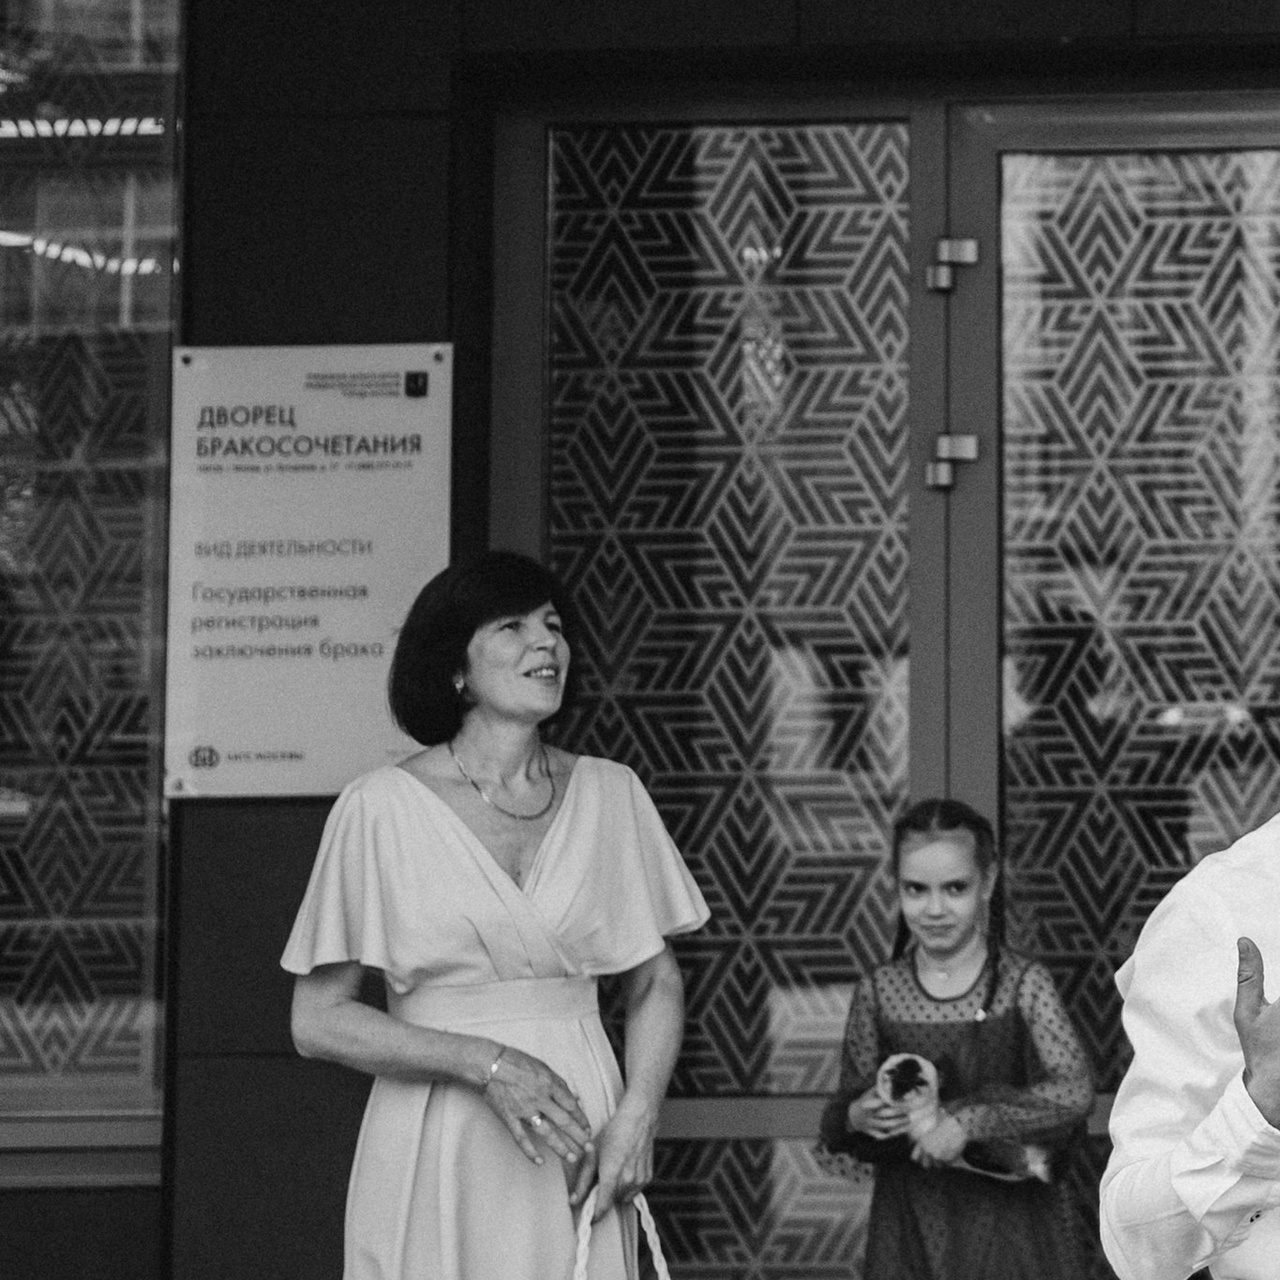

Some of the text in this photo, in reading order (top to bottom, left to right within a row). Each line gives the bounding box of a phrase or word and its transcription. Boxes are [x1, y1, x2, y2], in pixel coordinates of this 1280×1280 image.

[197, 404, 297, 431] ДВОРЕЦ
[197, 433, 422, 458] БРАКОСОЧЕТАНИЯ
[194, 538, 373, 561] ВИД ДЕЯТЕЛЬНОСТИ
[192, 581, 367, 606] Государственная
[191, 615, 320, 634] регистрация
[319, 637, 384, 662] брака
